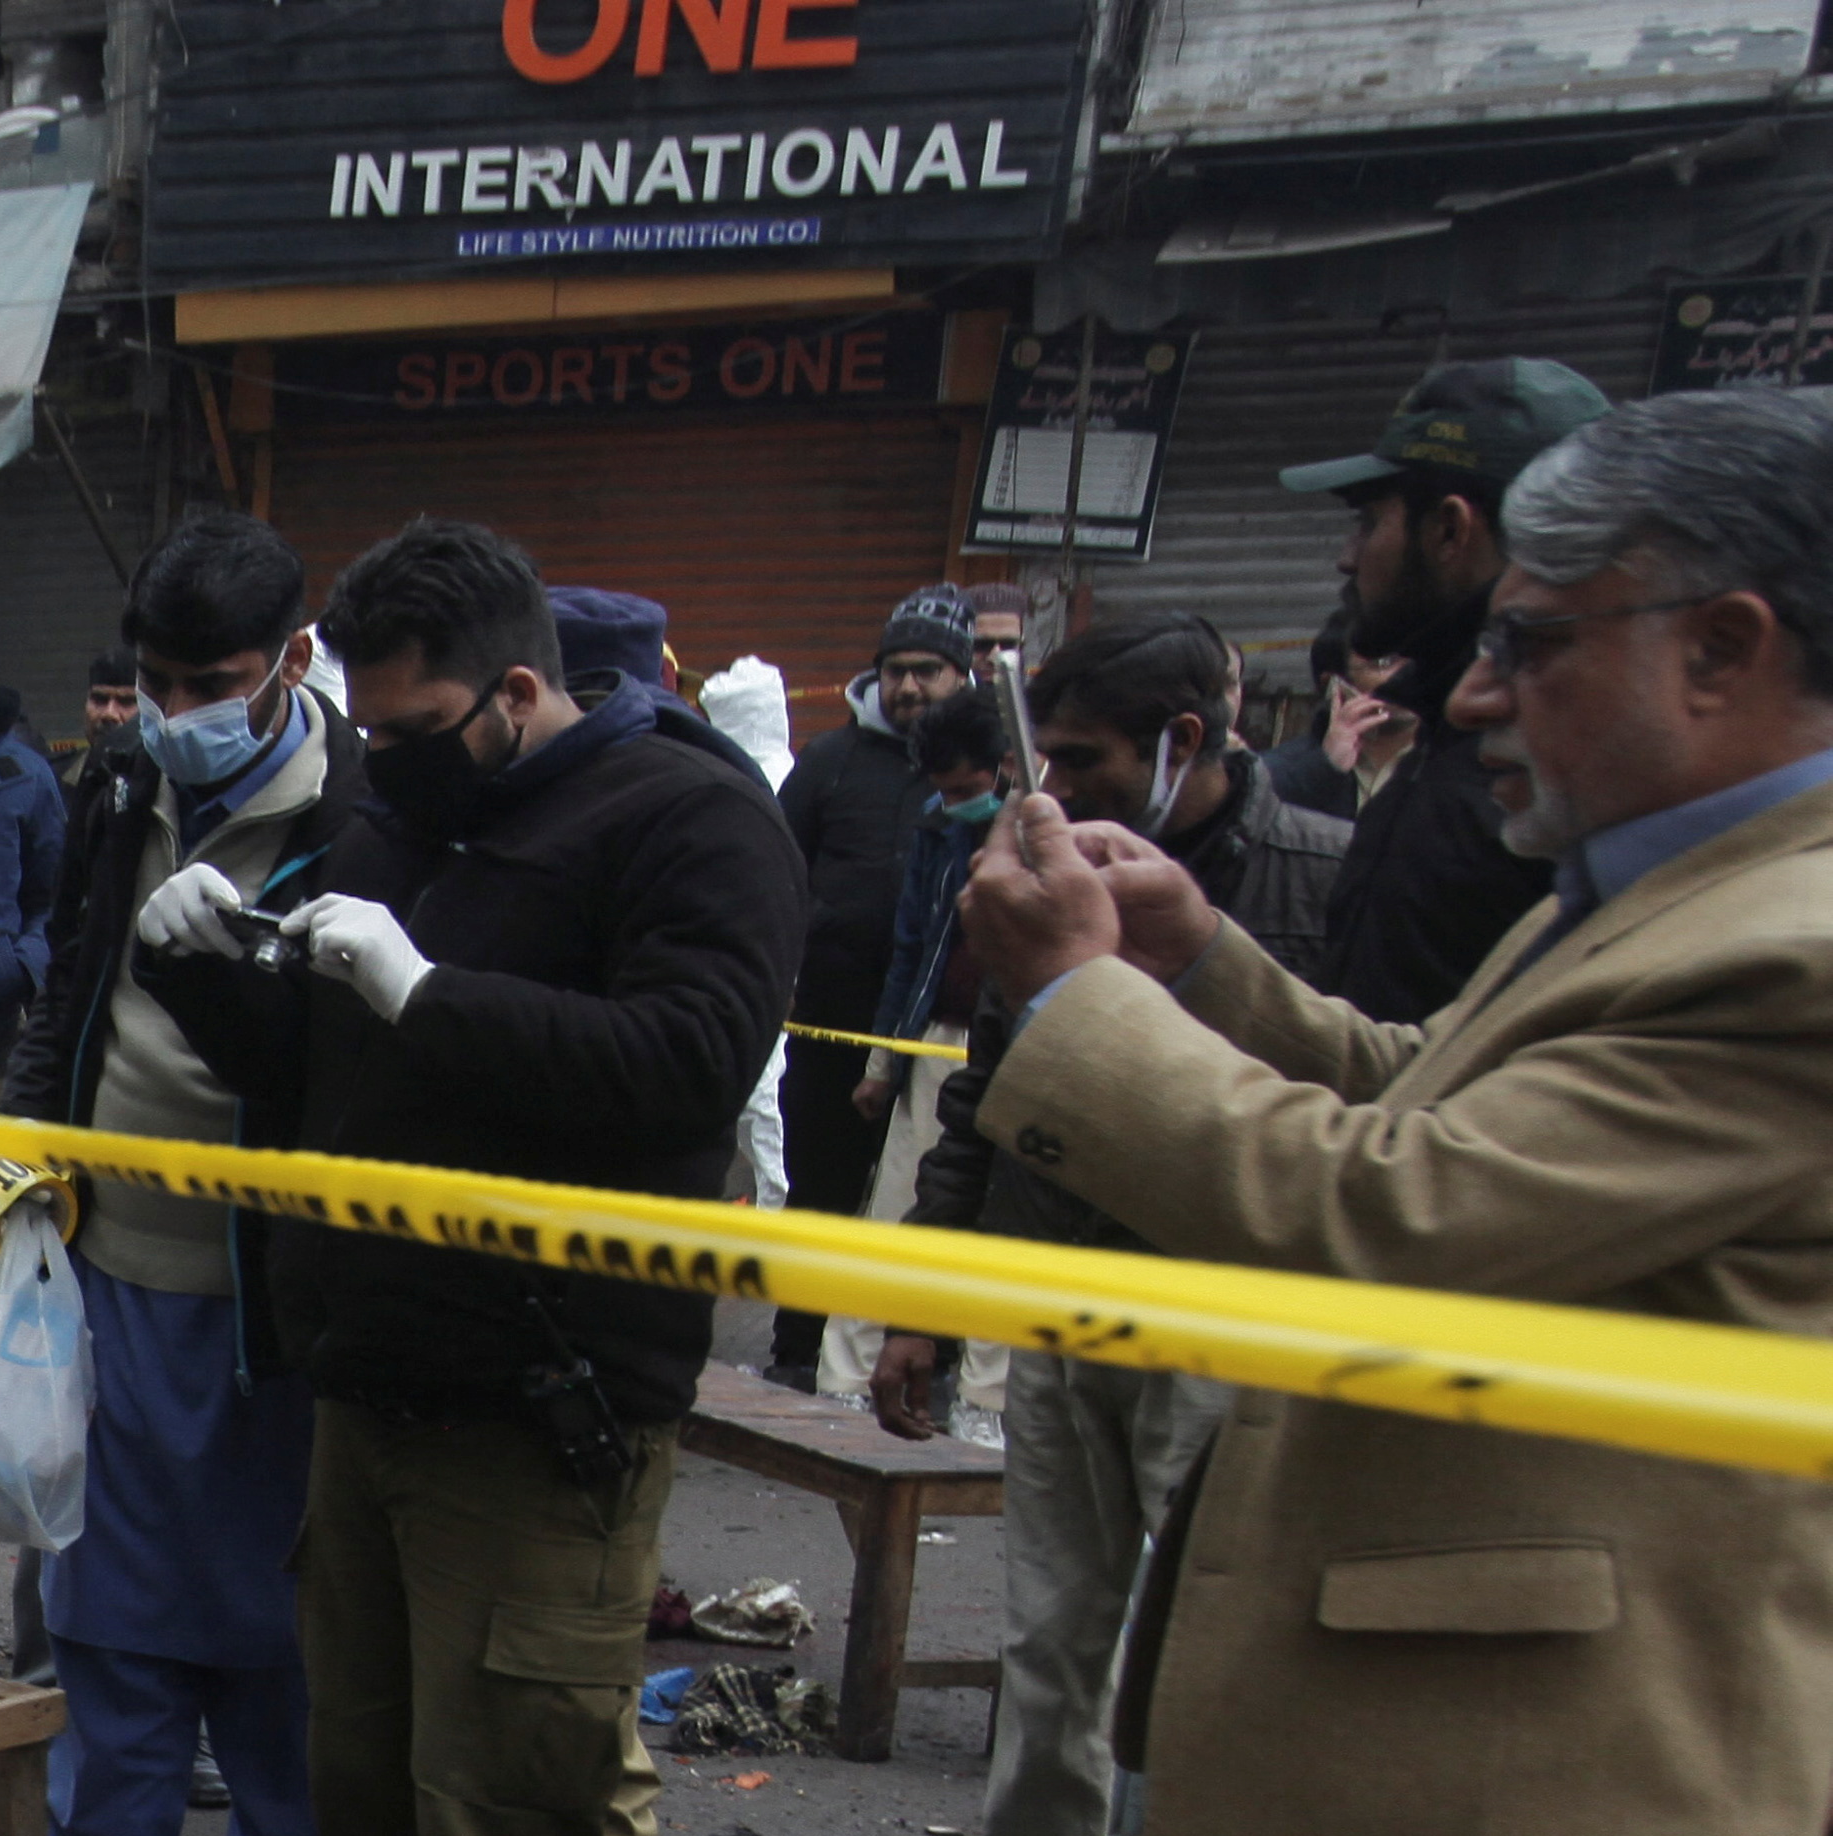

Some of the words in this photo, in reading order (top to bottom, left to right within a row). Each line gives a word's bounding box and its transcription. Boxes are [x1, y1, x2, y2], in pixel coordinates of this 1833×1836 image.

[501, 0, 859, 84] ONE
[330, 120, 1029, 218] INTERNATIONAL
[459, 233, 512, 256] LIFE
[522, 228, 605, 252] STYLE
[613, 221, 758, 250] NUTRITION
[767, 218, 815, 245] CO.
[394, 343, 692, 411] SPORTS
[718, 328, 889, 399] ONE
